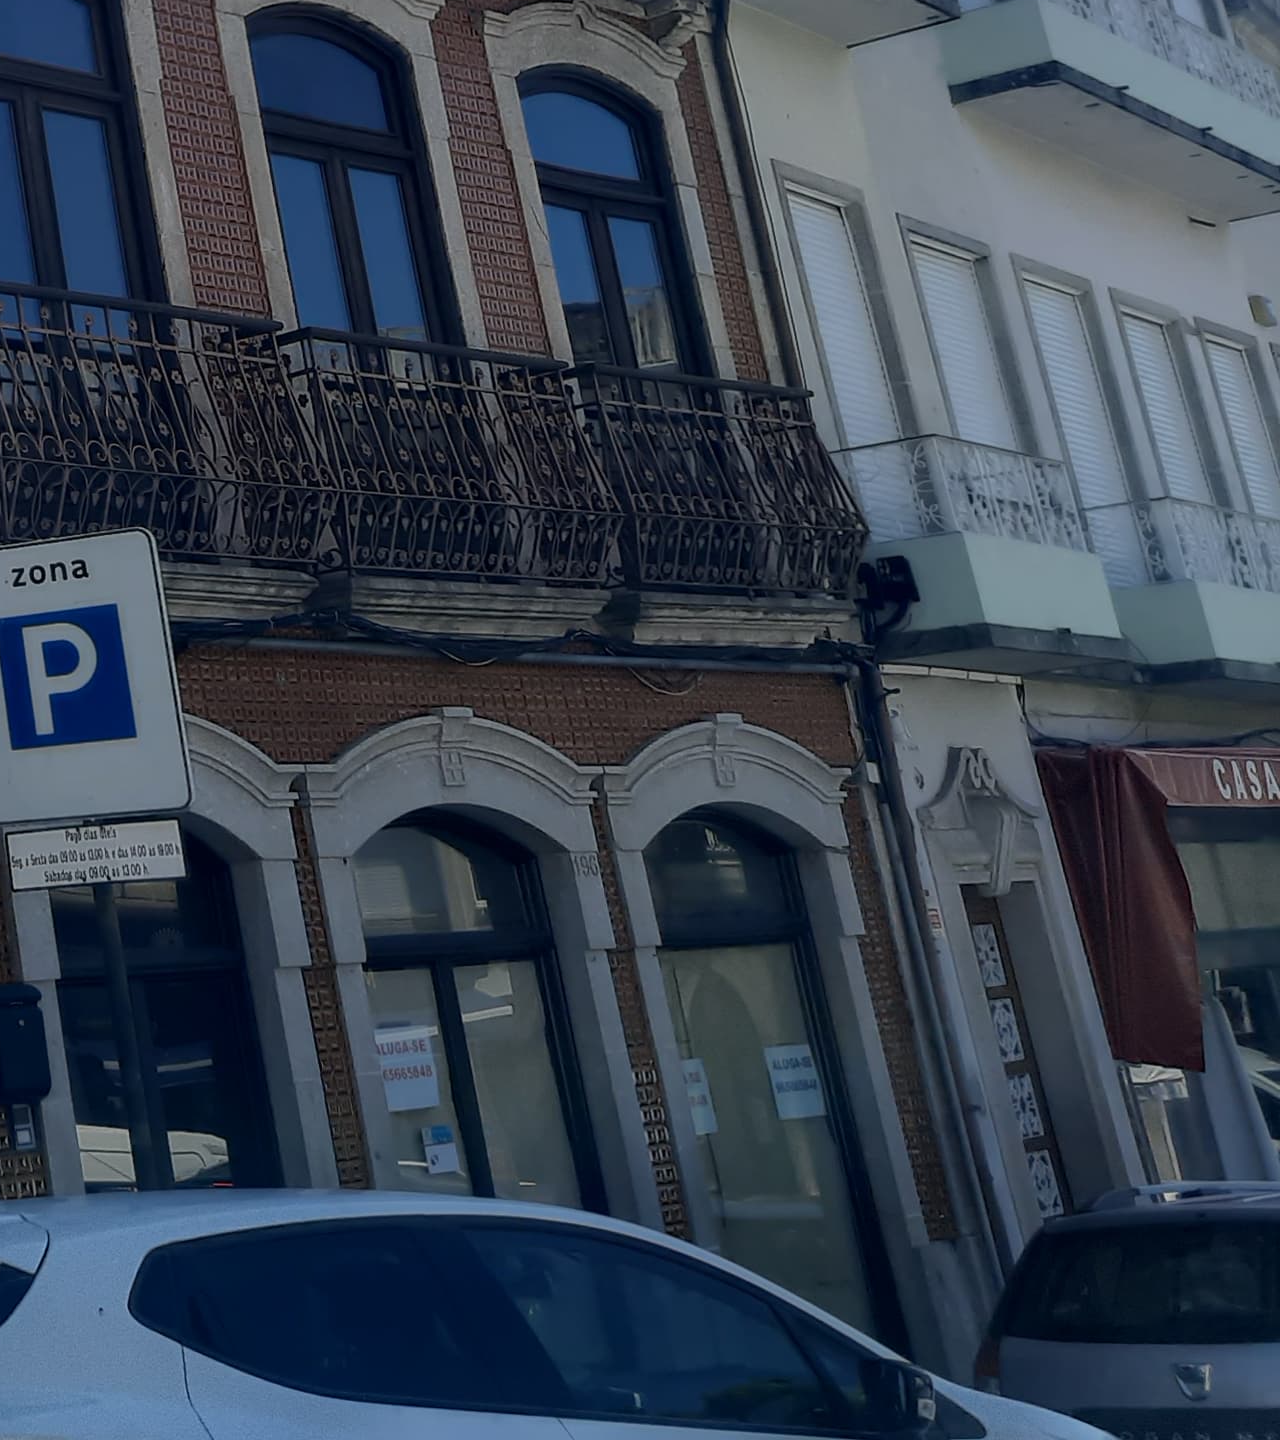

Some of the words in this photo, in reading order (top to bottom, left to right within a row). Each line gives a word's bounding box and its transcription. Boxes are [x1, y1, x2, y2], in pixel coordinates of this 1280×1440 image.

[11, 559, 90, 588] zona
[21, 622, 98, 737] P
[1213, 759, 1280, 800] CASA
[574, 855, 598, 877] 196
